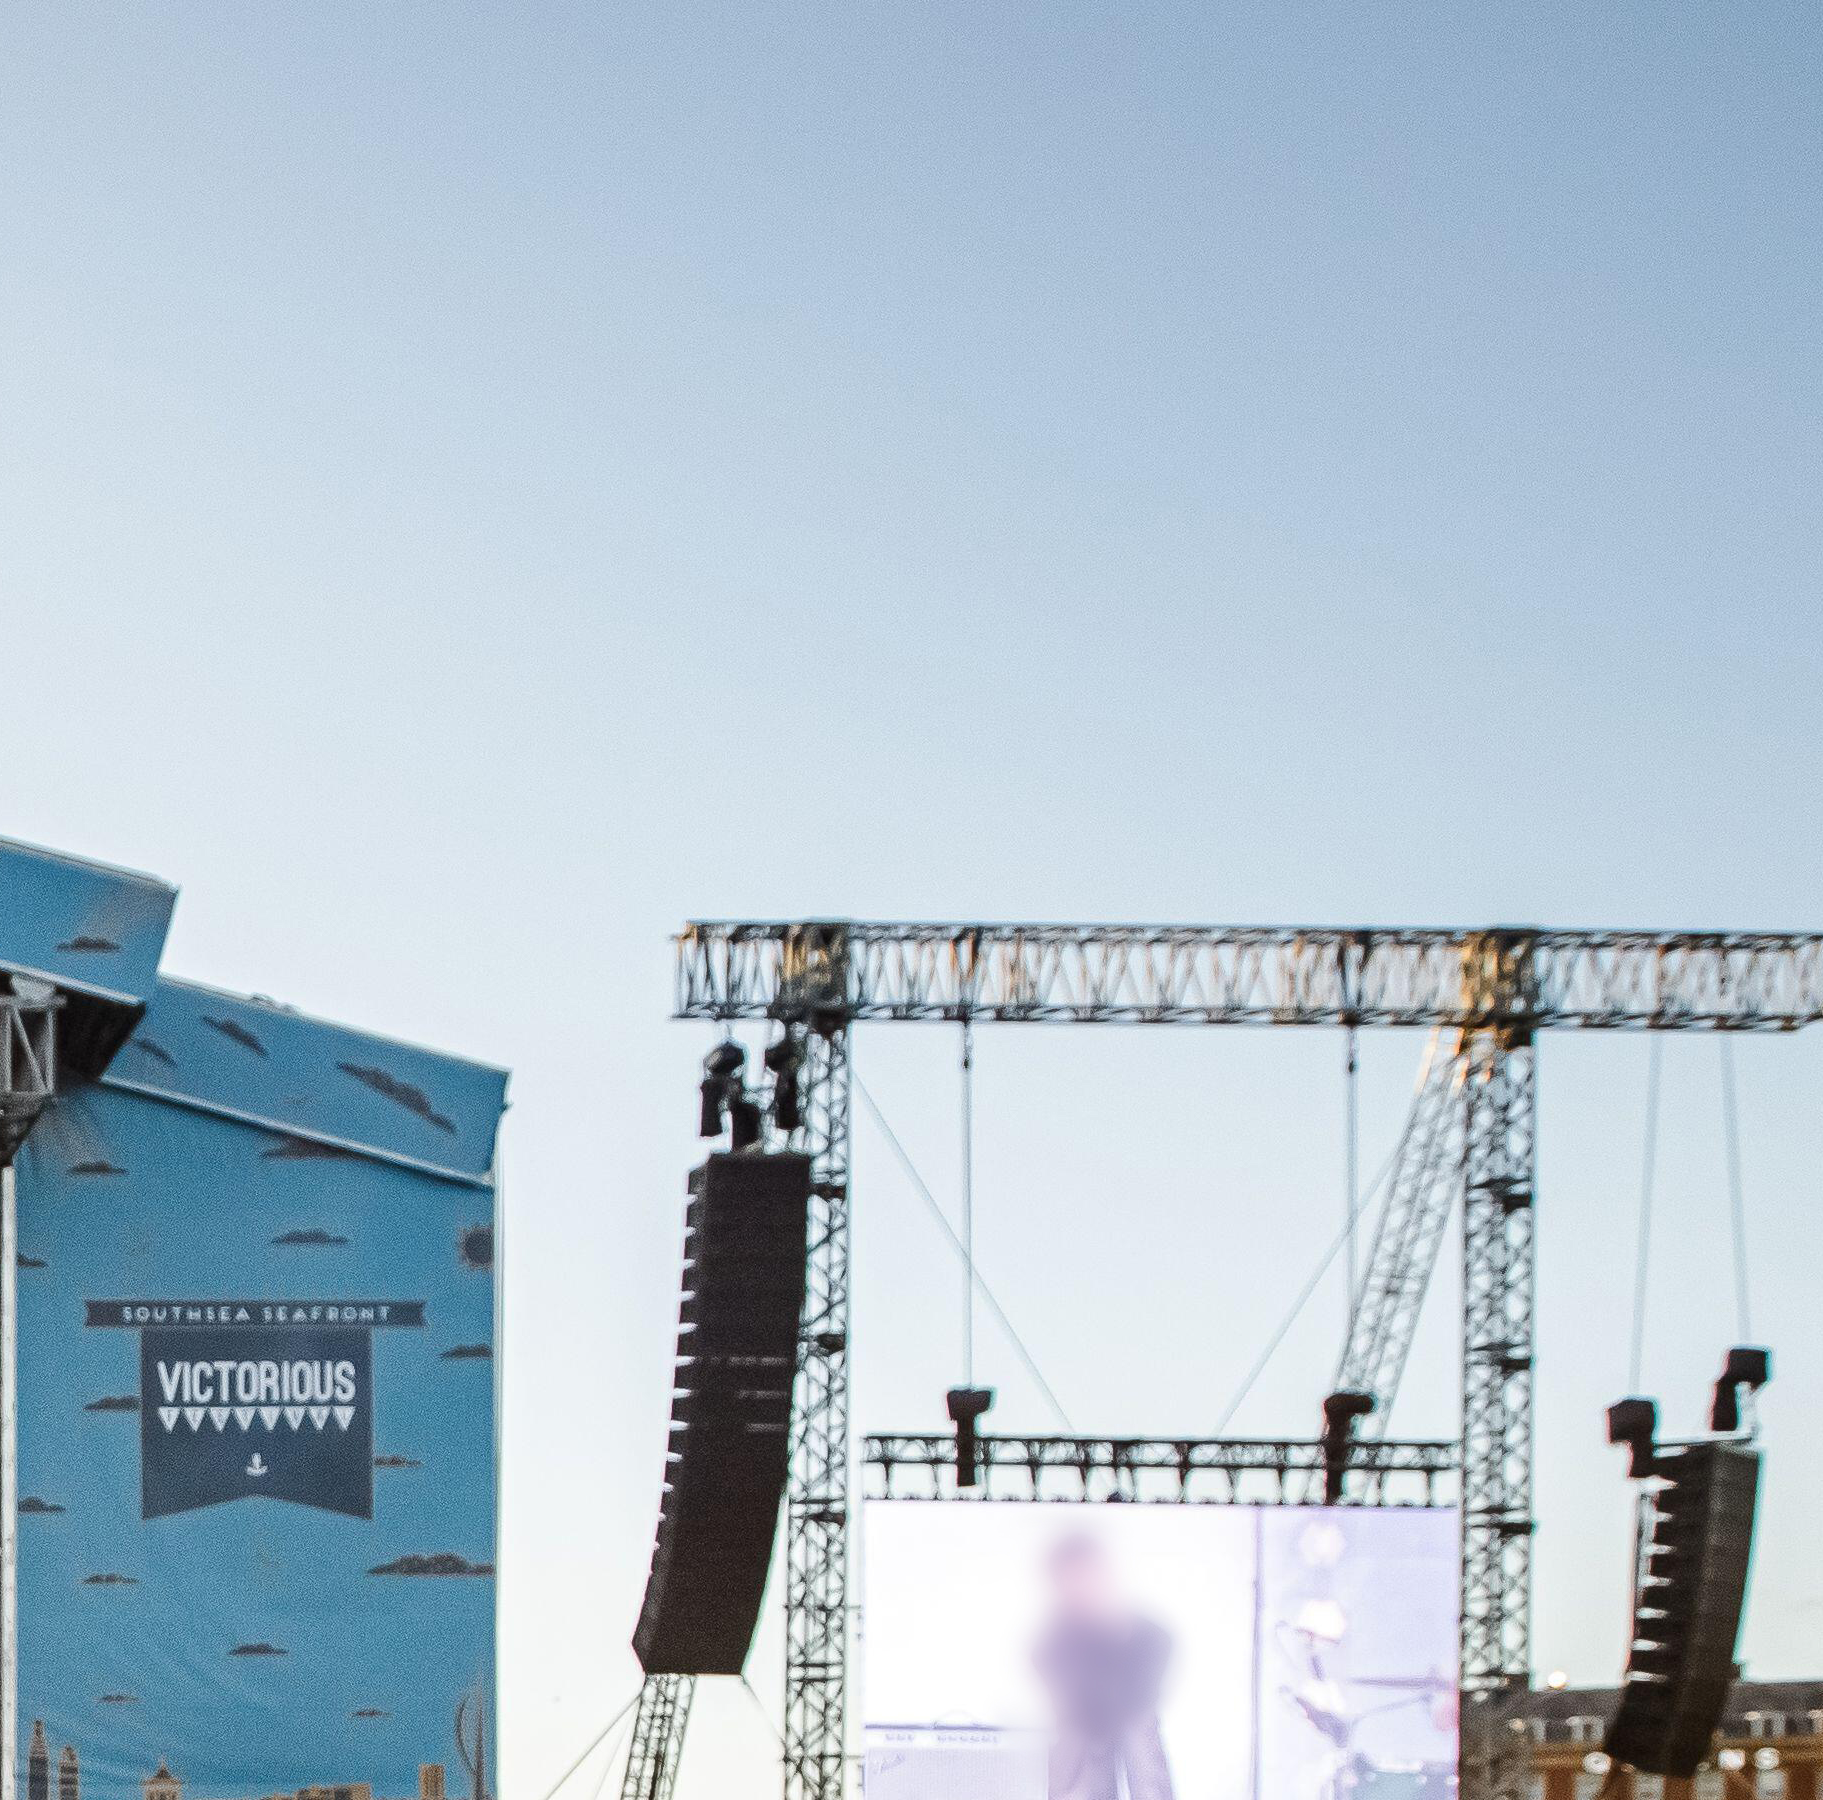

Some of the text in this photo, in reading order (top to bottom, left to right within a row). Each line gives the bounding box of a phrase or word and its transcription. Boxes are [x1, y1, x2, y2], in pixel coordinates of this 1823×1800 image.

[121, 1305, 392, 1323] SOUTHSEA SEAFRONT
[156, 1360, 356, 1403] VICTORIOUS
